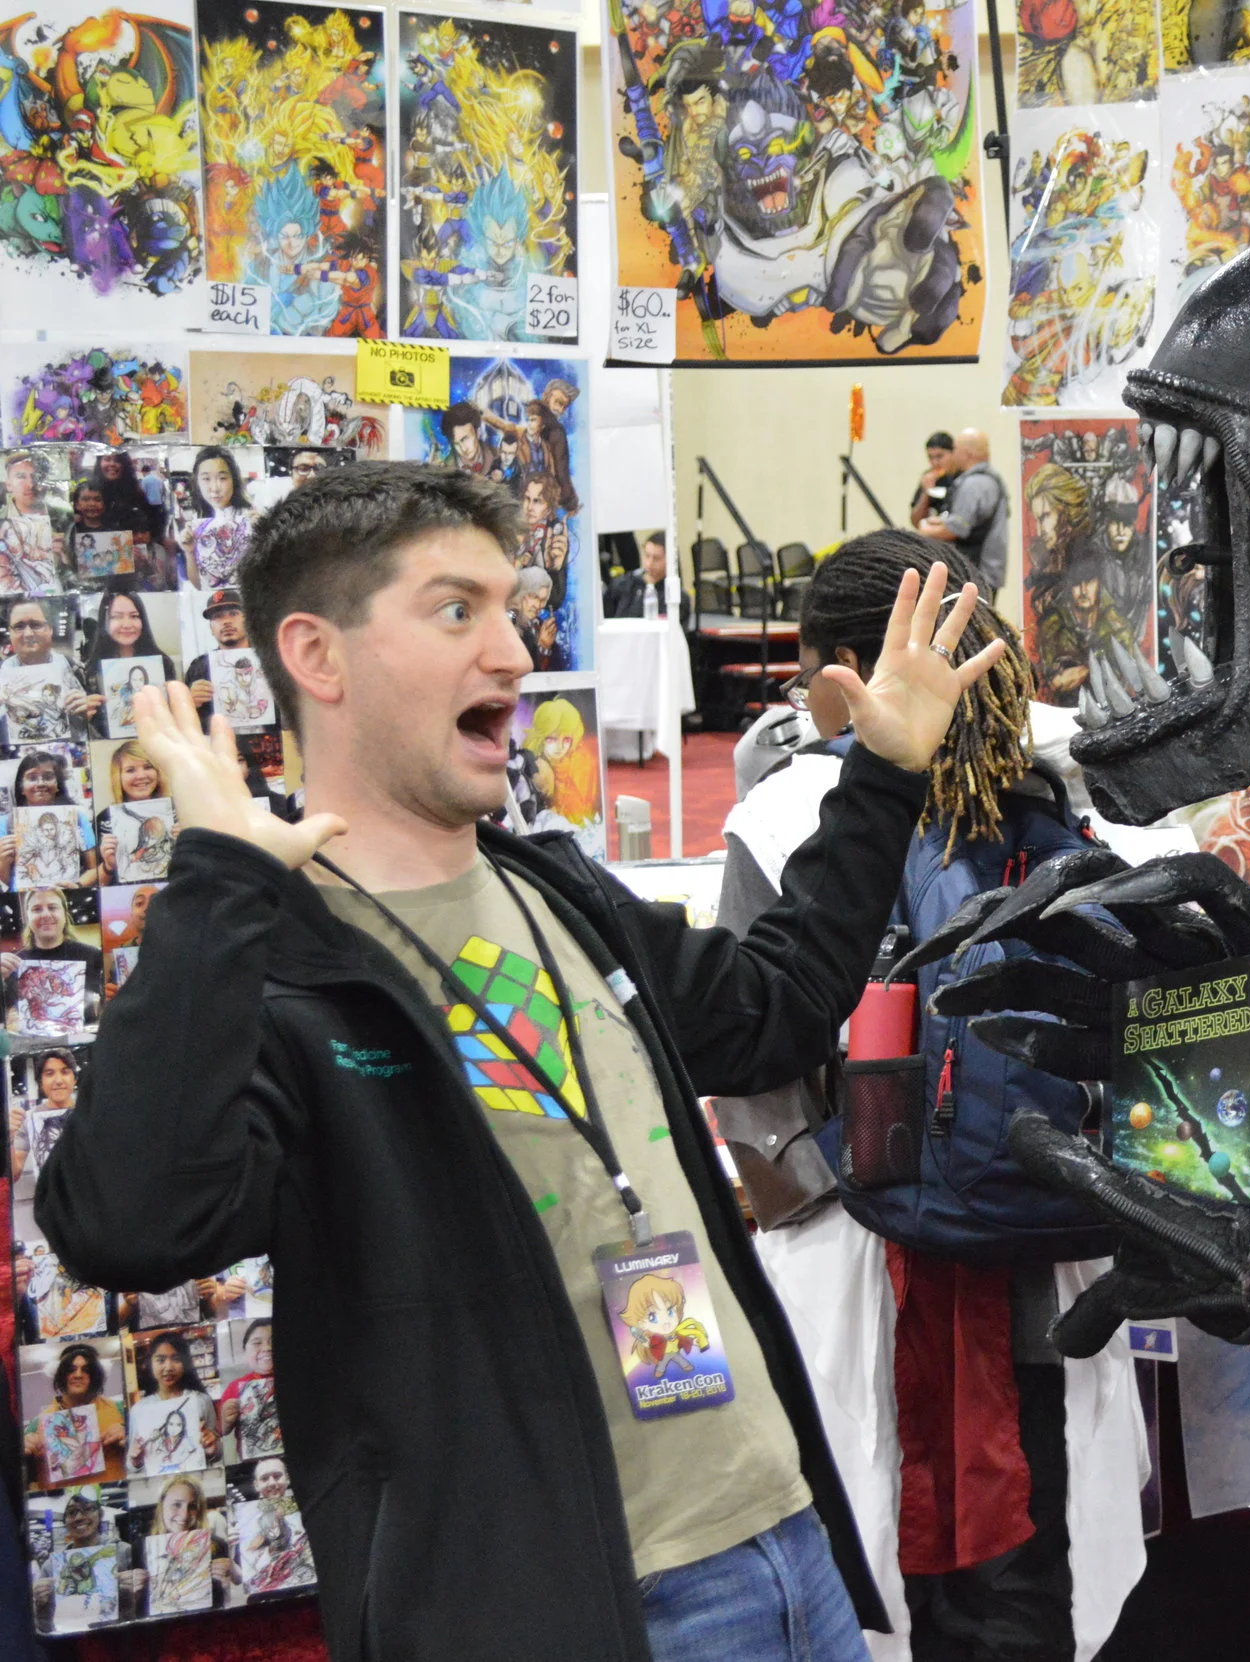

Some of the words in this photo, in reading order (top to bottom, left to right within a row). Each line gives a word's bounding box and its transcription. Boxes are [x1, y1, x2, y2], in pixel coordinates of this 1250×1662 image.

[210, 283, 257, 307] $15
[529, 284, 545, 303] 2
[547, 285, 575, 304] for
[210, 308, 260, 330] each
[528, 307, 570, 330] $20
[614, 320, 630, 334] for
[635, 321, 657, 334] XL
[370, 346, 387, 358] NO
[389, 349, 436, 364] PHOTOS
[1127, 998, 1139, 1018] A
[1142, 974, 1248, 1019] GALAXY
[614, 1252, 680, 1274] LUMINARY
[636, 1377, 694, 1401] Kraken
[694, 1372, 726, 1388] Con
